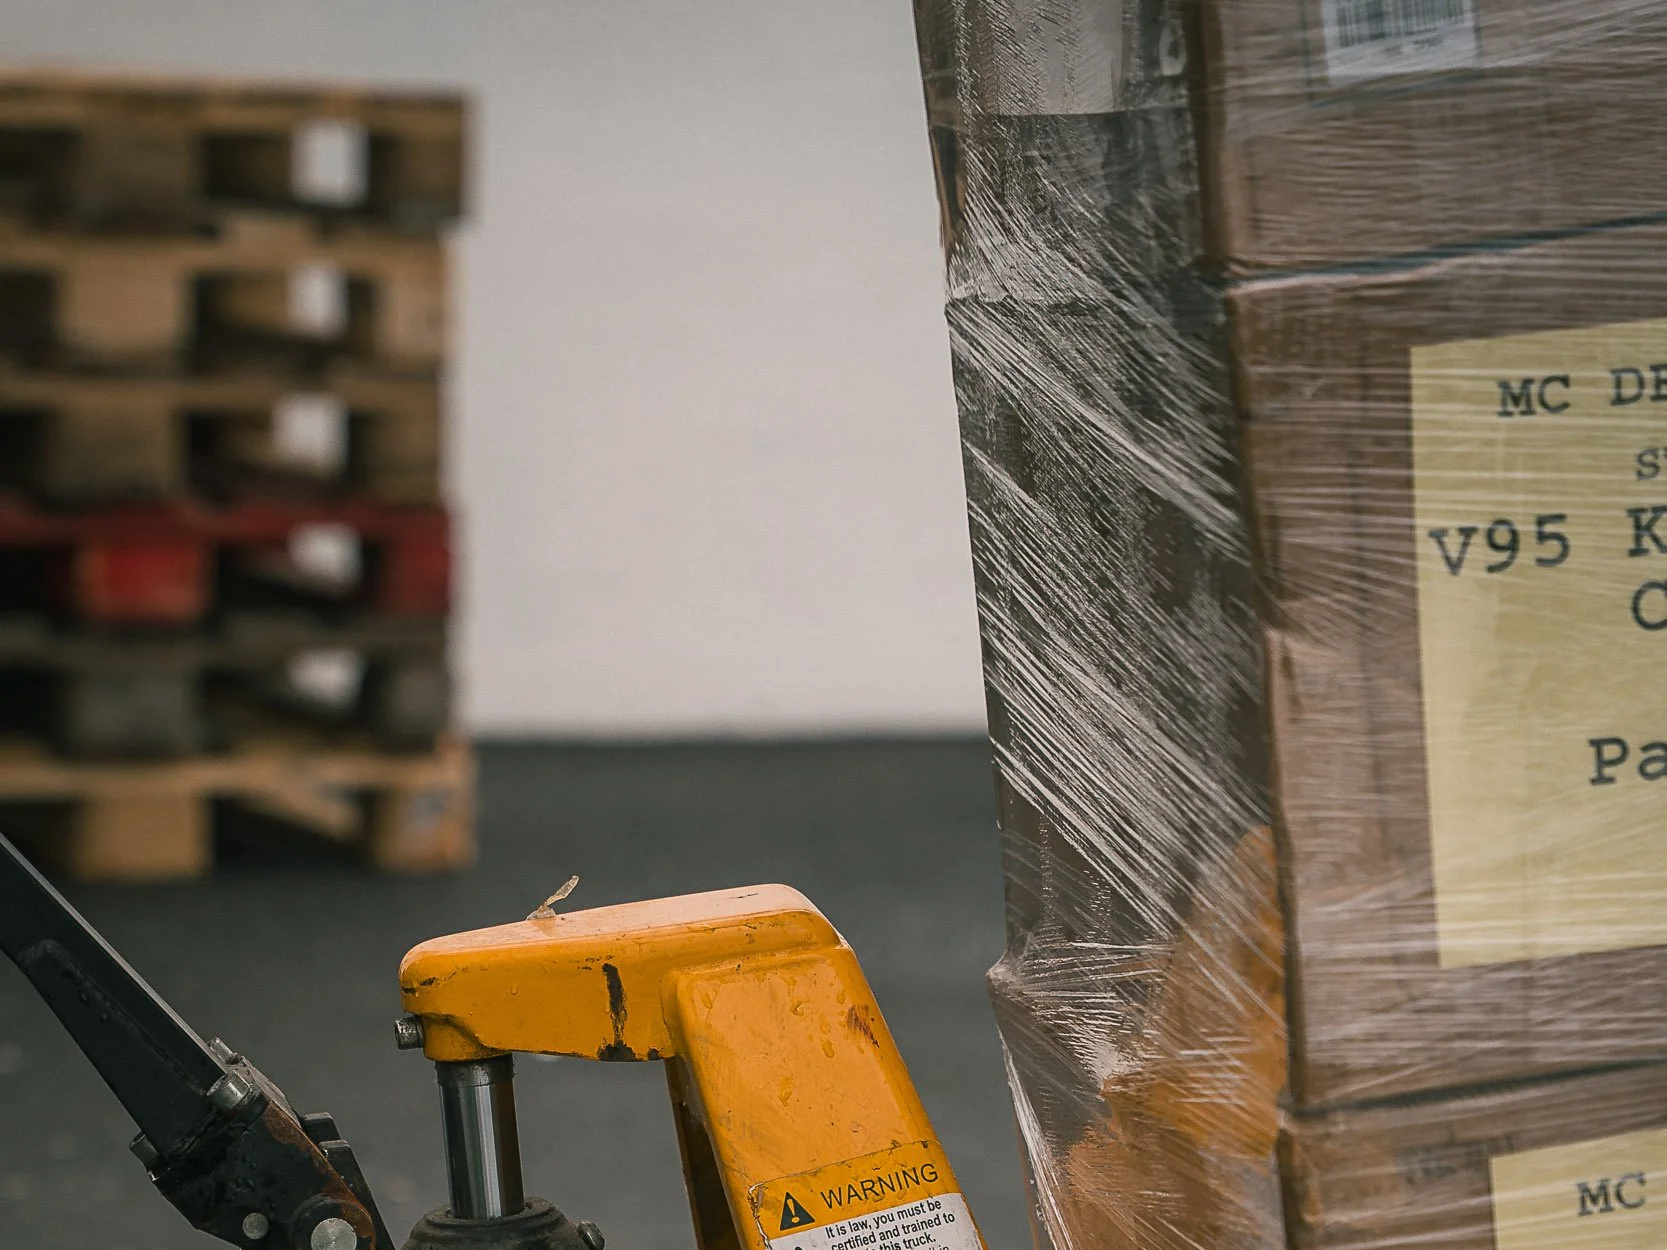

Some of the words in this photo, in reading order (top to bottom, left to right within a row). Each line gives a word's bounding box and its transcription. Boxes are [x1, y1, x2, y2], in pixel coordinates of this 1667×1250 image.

[1497, 374, 1572, 417] MC
[1635, 446, 1667, 481] S
[1427, 513, 1572, 576] V95
[819, 1163, 939, 1210] WARNING
[1577, 1172, 1647, 1216] MC
[825, 1226, 836, 1239] It
[835, 1224, 847, 1236] is
[872, 1212, 896, 1230] you
[896, 1202, 927, 1221] must
[926, 1199, 942, 1212] be
[878, 1224, 901, 1242] and
[901, 1213, 942, 1235] trained
[942, 1212, 956, 1224] to
